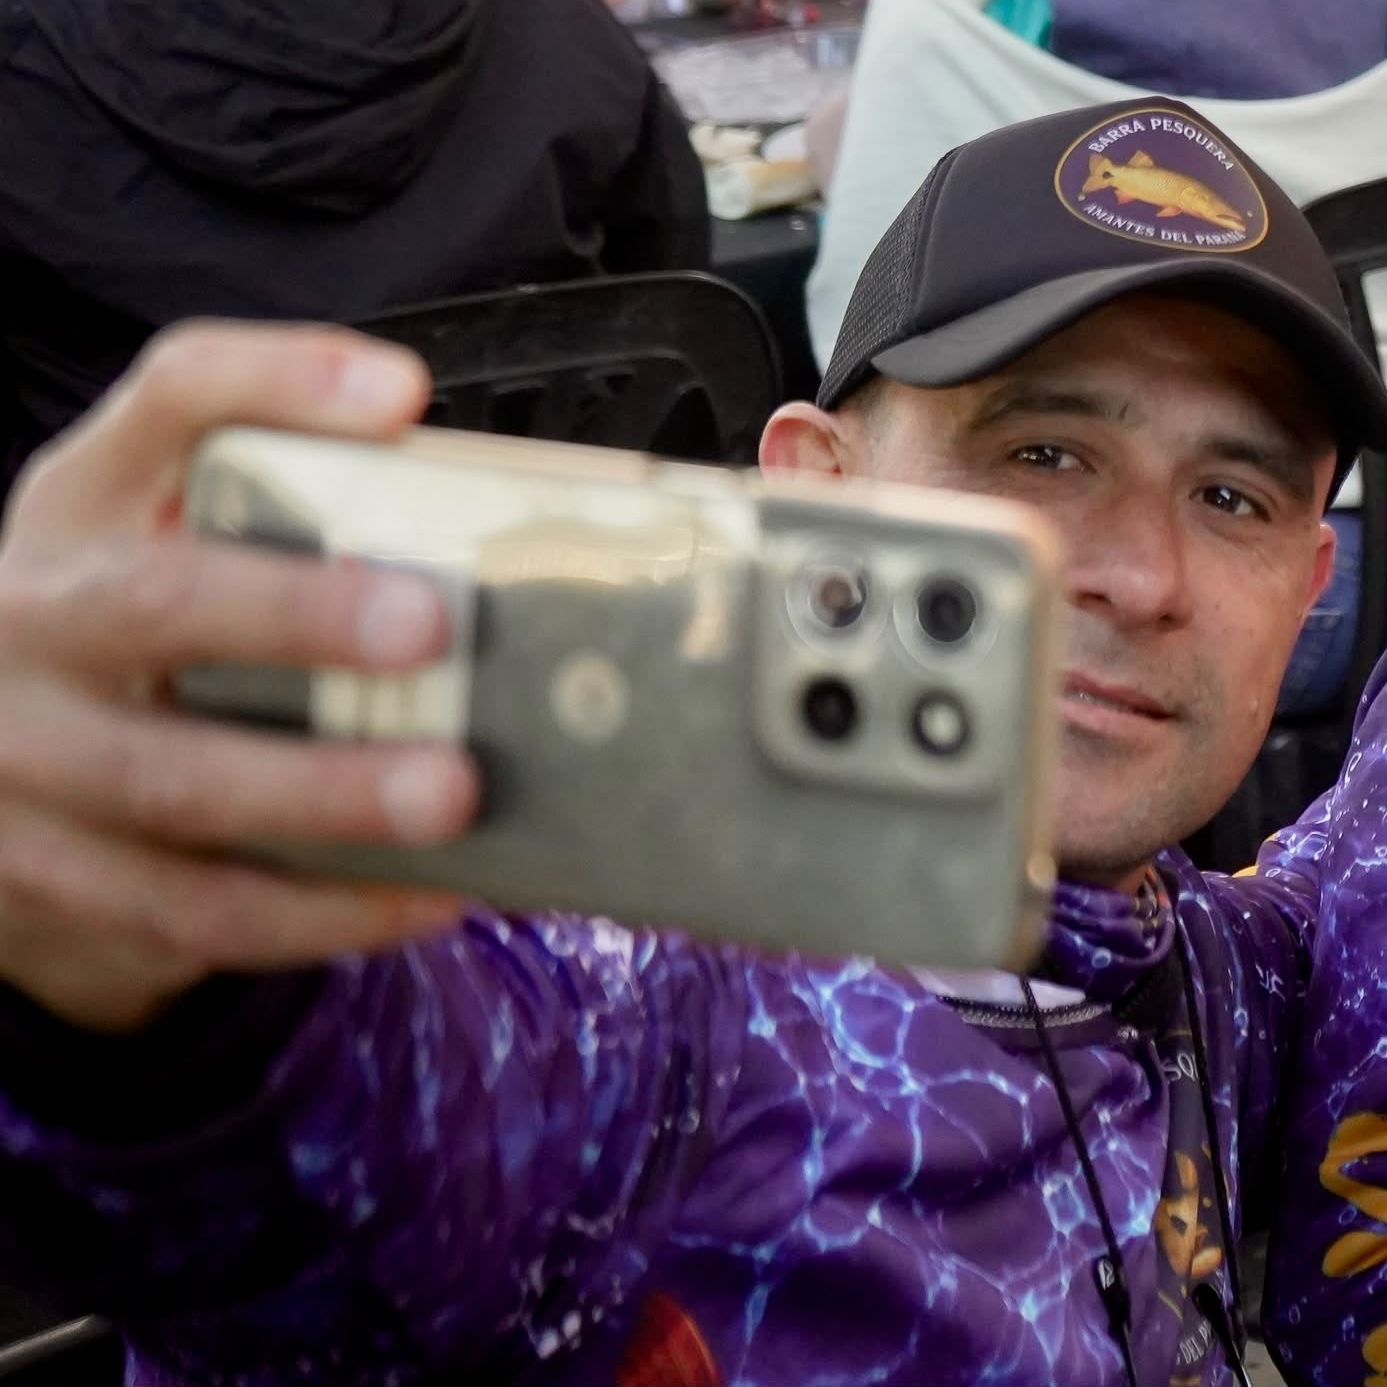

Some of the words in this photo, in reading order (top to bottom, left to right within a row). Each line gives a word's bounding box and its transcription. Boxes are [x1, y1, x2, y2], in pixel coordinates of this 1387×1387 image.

[1088, 117, 1146, 154] BARRA
[1151, 117, 1234, 171] PESQUERA
[1083, 202, 1155, 238] AMANTES
[1160, 228, 1194, 244] DEL
